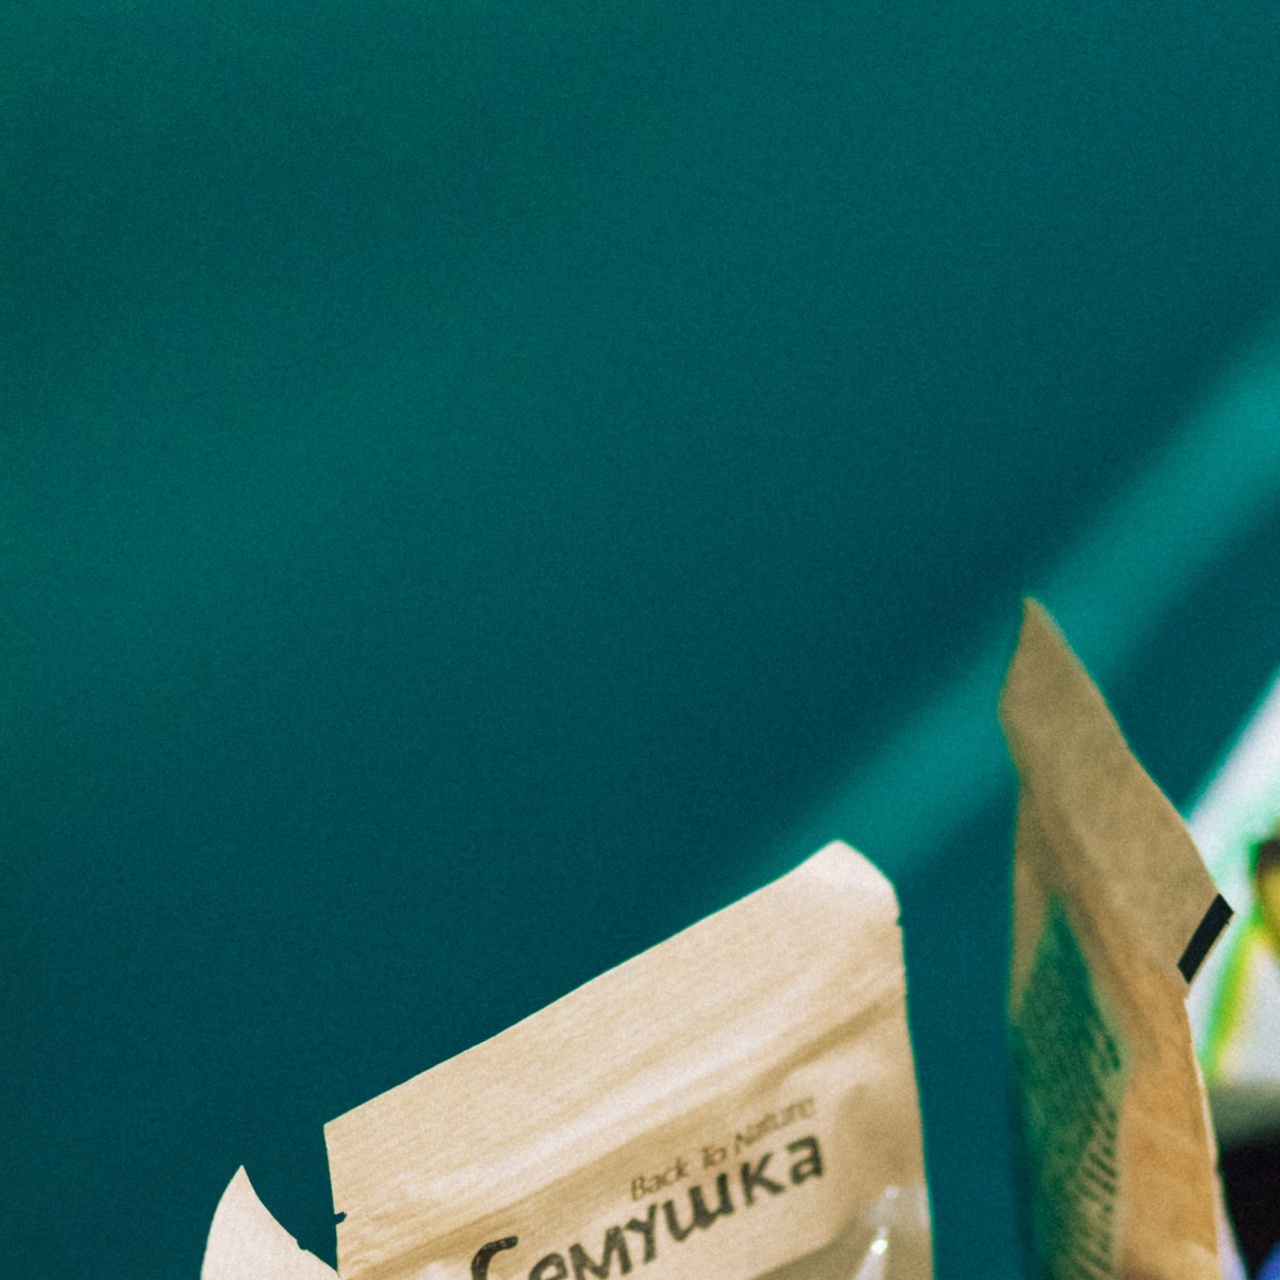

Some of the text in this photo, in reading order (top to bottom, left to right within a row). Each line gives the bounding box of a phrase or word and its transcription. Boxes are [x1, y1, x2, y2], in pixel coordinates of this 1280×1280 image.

[630, 1097, 815, 1201] Back To Nature
